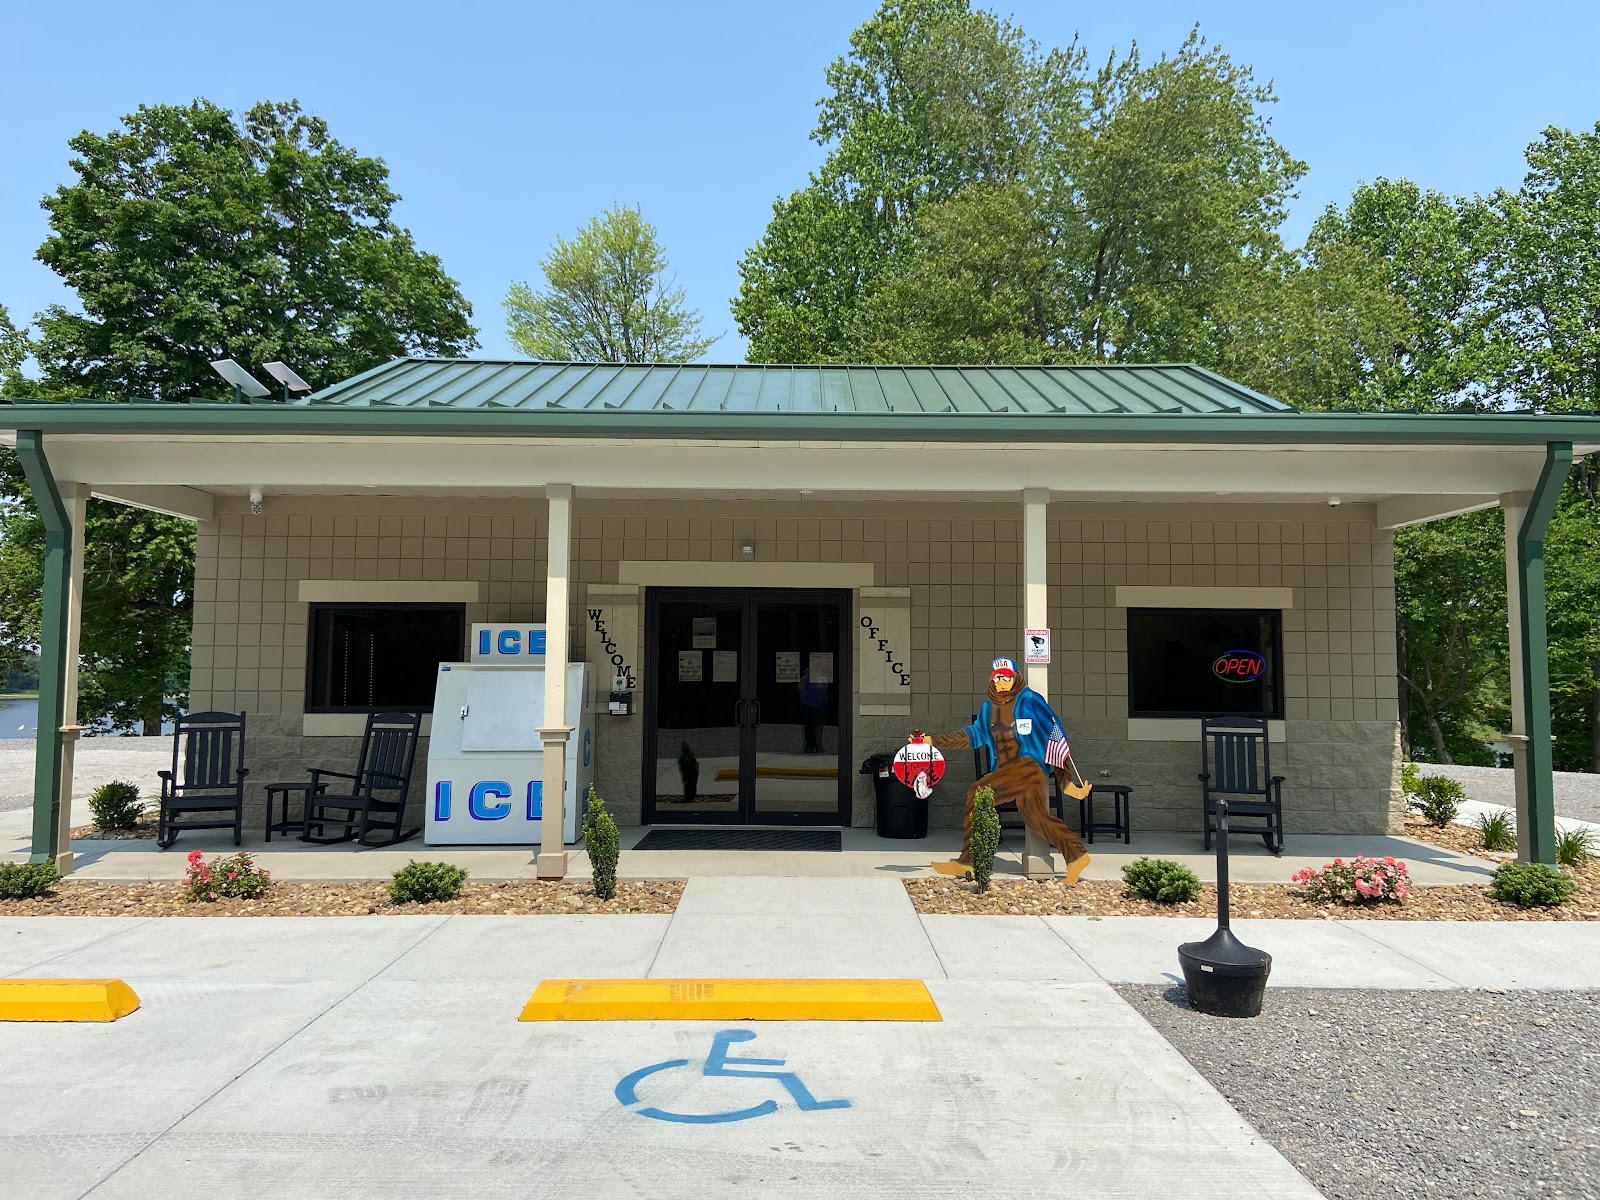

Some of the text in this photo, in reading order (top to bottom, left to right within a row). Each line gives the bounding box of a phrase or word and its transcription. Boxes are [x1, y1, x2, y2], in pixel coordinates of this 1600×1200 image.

[588, 609, 636, 688] WELCOME
[860, 616, 910, 685] OFFICE
[1215, 659, 1261, 675] OPEN
[899, 751, 939, 761] WELCOME
